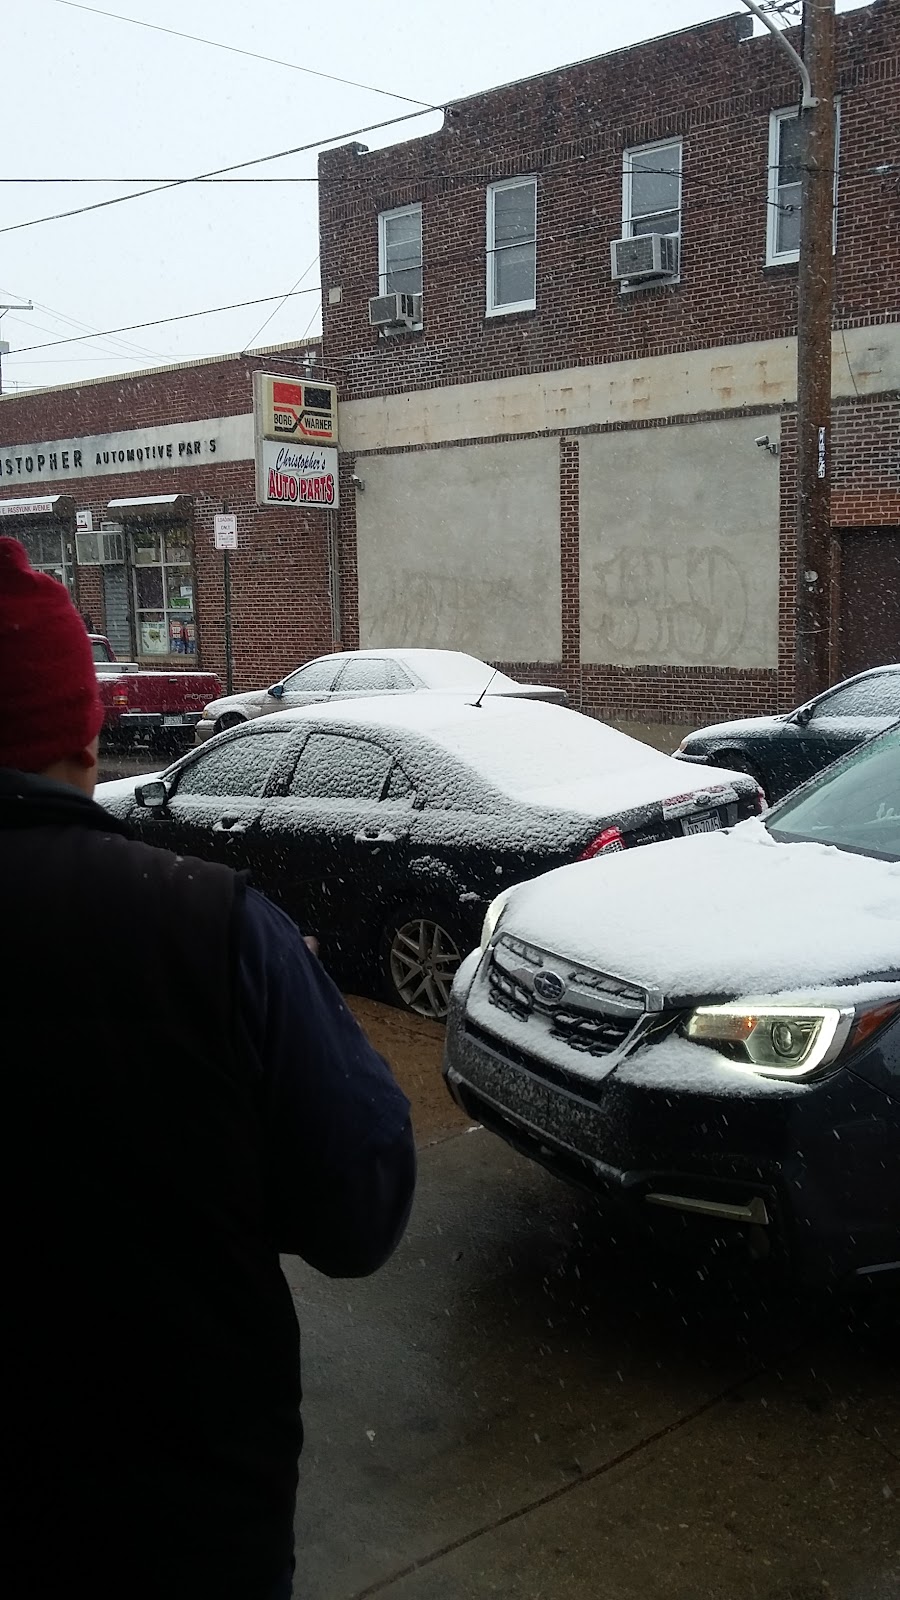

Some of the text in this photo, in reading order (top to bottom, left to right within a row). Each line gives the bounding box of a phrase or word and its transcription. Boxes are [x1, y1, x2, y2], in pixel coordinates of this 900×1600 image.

[274, 413, 332, 430] BORG WARNER
[96, 443, 172, 465] AUTOMOTIVE
[178, 439, 216, 457] PARS
[275, 447, 326, 472] Christopher's
[267, 467, 335, 505] AUTO PARTS
[7, 505, 32, 514] PASSYUNK
[32, 503, 51, 512] AVENUE
